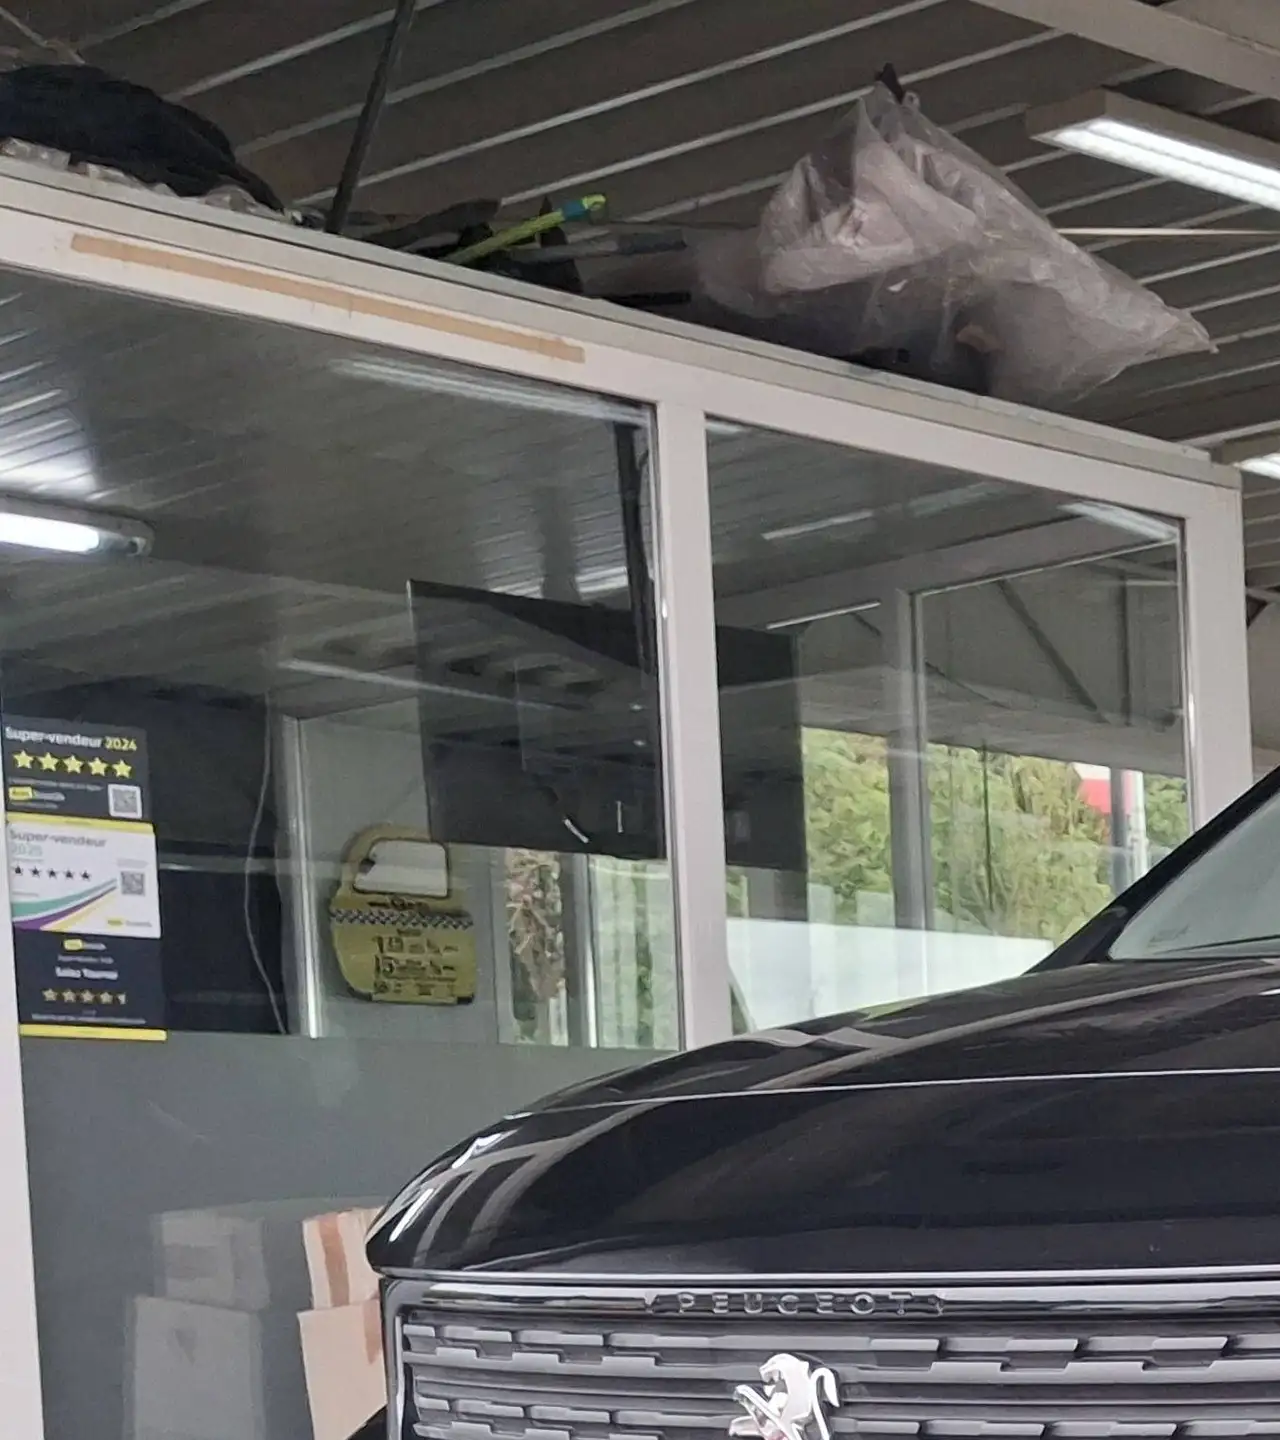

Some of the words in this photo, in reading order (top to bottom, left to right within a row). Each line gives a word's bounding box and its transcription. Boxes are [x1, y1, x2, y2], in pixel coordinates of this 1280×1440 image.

[5, 726, 102, 748] Super-vendeur
[104, 735, 138, 752] 2024
[677, 1290, 913, 1315] PEUGEOT
